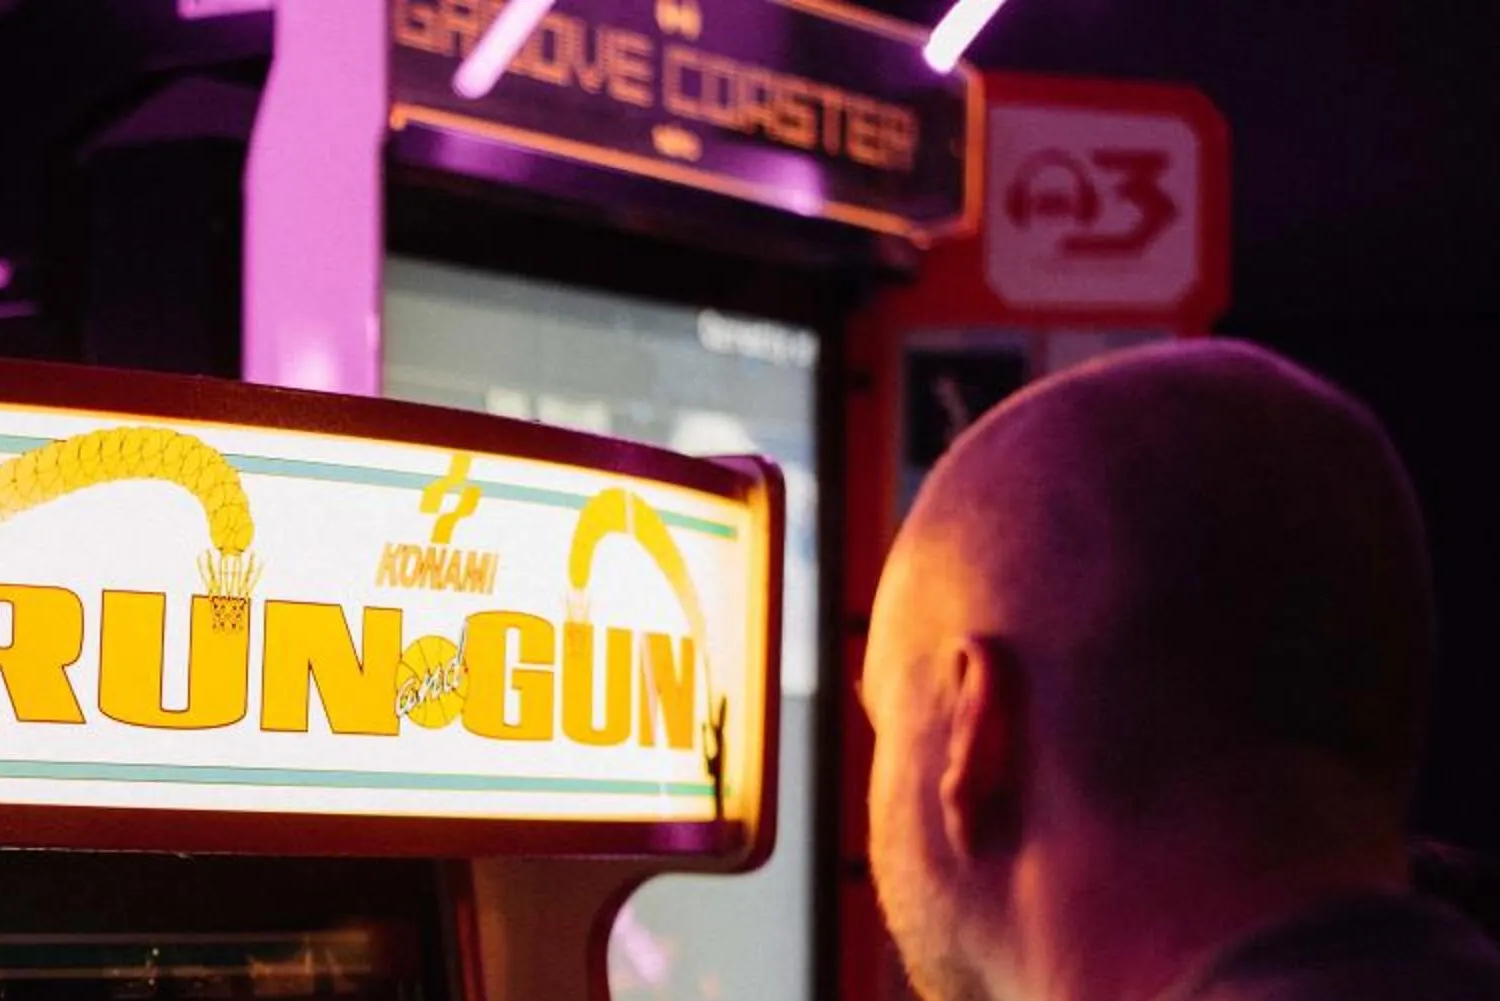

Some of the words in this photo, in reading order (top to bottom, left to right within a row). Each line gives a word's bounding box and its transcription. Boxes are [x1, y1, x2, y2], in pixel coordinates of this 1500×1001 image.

[393, 0, 653, 107] GROVE
[662, 45, 918, 172] COASTER
[375, 541, 498, 595] KONAMI
[395, 617, 468, 720] and
[462, 609, 695, 750] GUN
